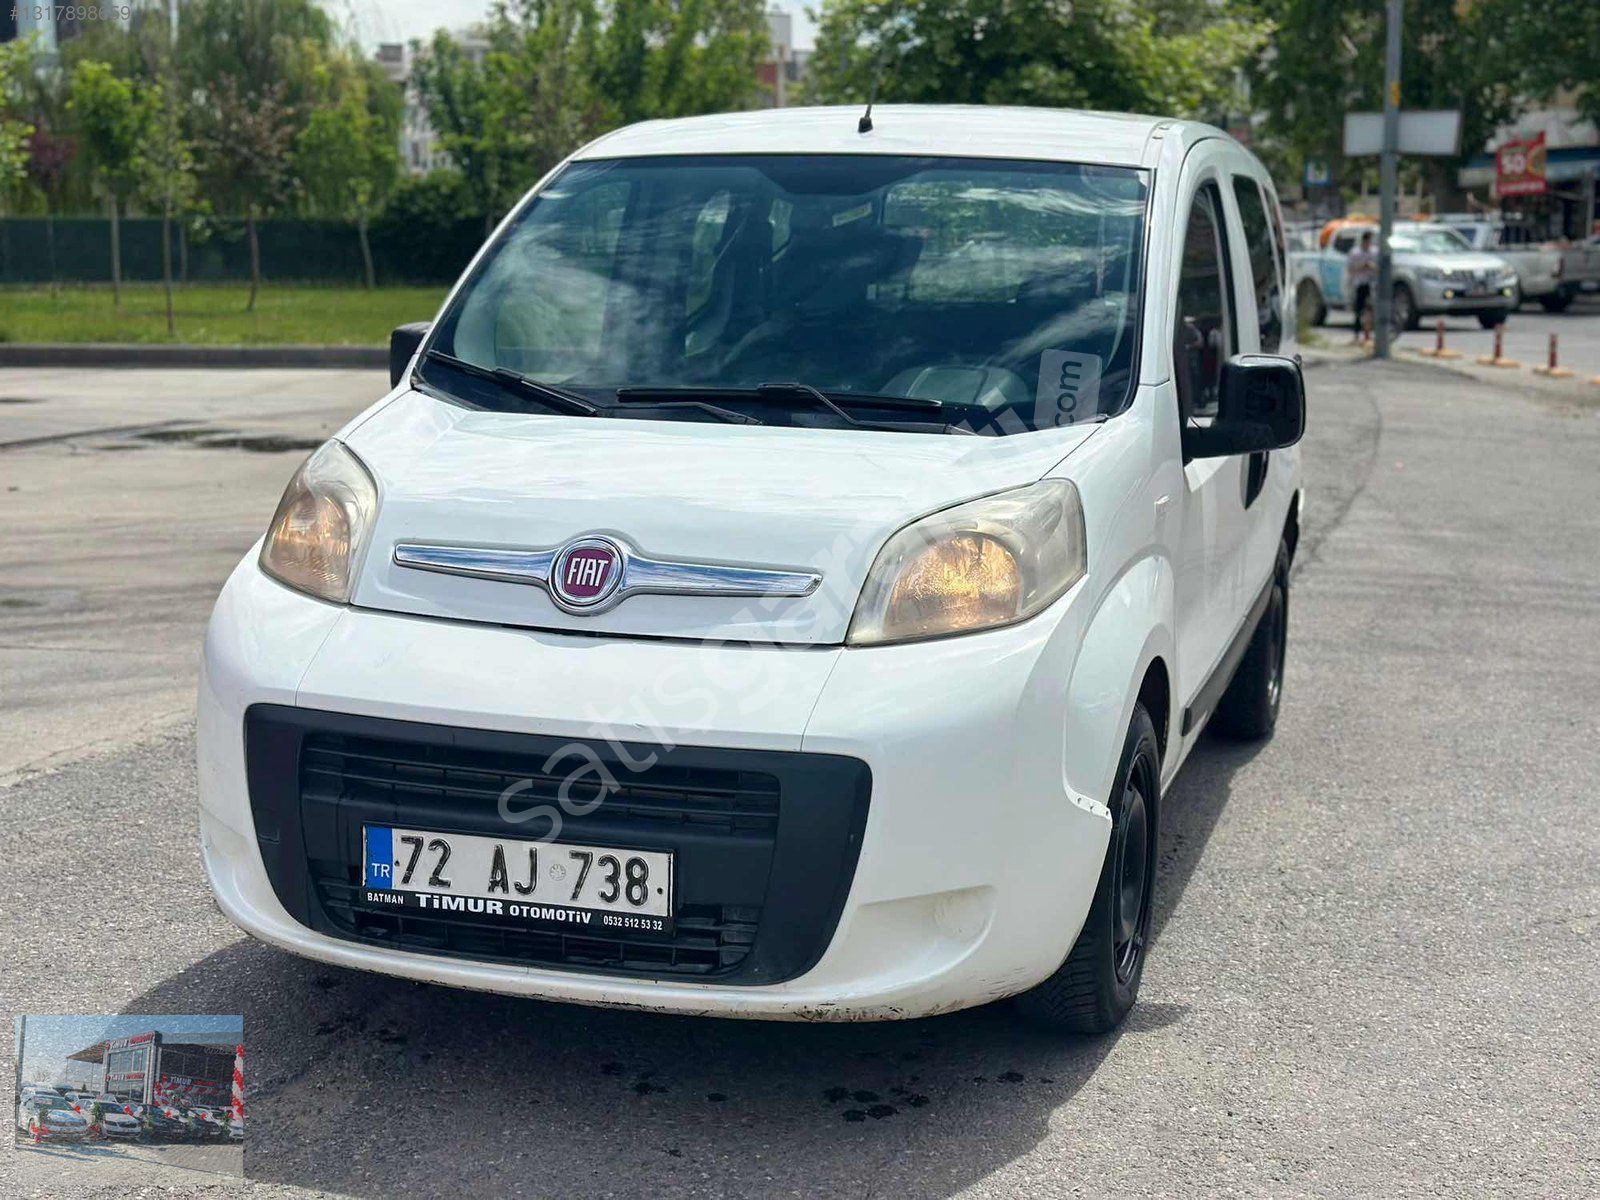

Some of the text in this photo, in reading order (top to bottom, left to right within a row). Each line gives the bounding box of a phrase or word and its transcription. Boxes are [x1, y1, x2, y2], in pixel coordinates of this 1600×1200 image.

[567, 557, 609, 587] FIAT
[371, 863, 390, 878] TR
[400, 835, 650, 907] 72 AJ 738
[367, 892, 404, 905] BATMAN
[603, 915, 663, 931] 0532 512 53 32
